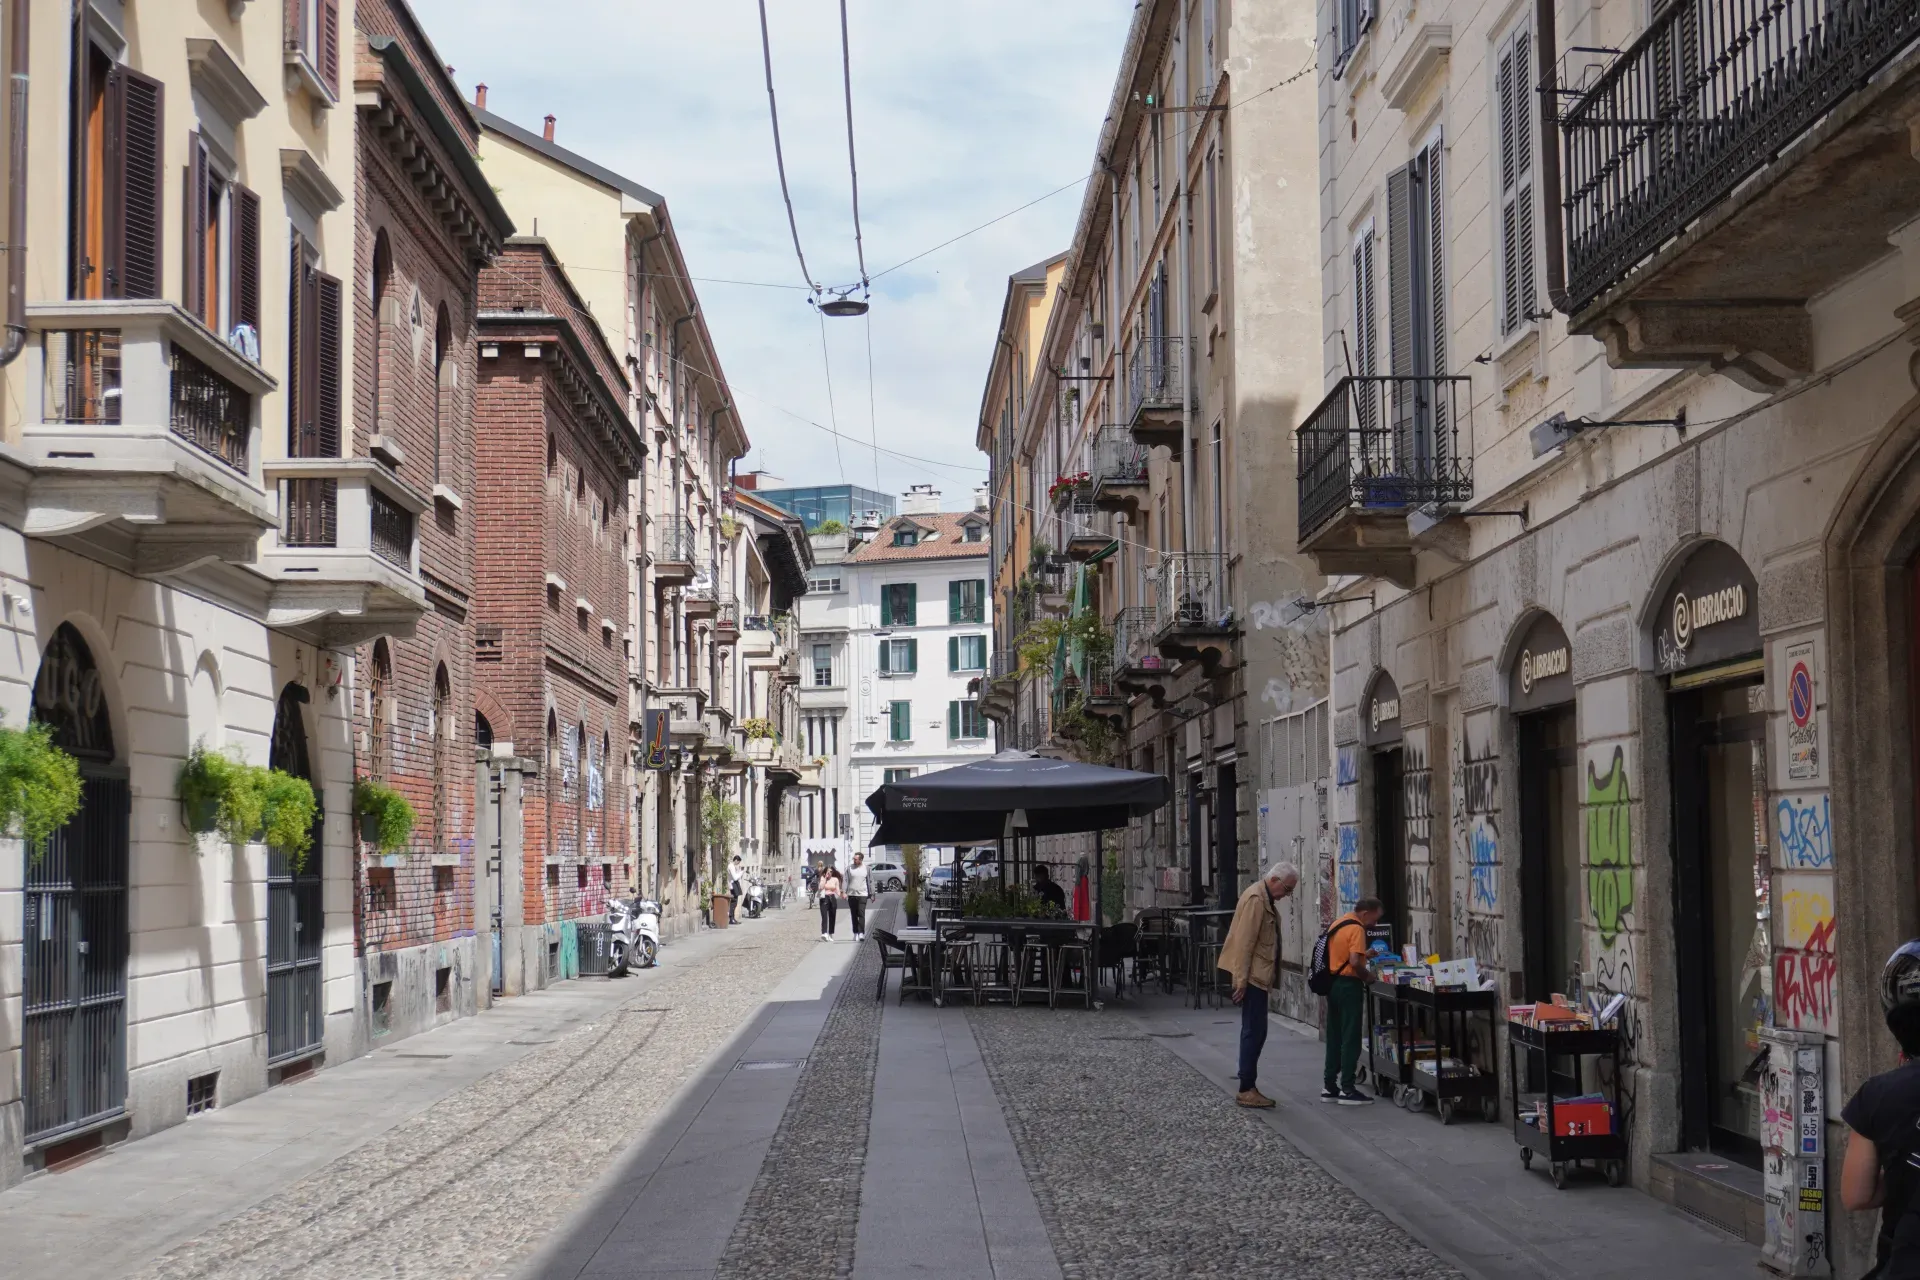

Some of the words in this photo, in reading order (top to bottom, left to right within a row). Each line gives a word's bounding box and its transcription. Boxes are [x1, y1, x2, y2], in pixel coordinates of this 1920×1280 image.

[1692, 584, 1743, 629] LIBRACCIO
[1533, 647, 1567, 679] LIBRACCIO
[1379, 699, 1399, 721] LIBRACCIO
[1803, 1123, 1810, 1135] OF
[1808, 1166, 1817, 1188] GAS
